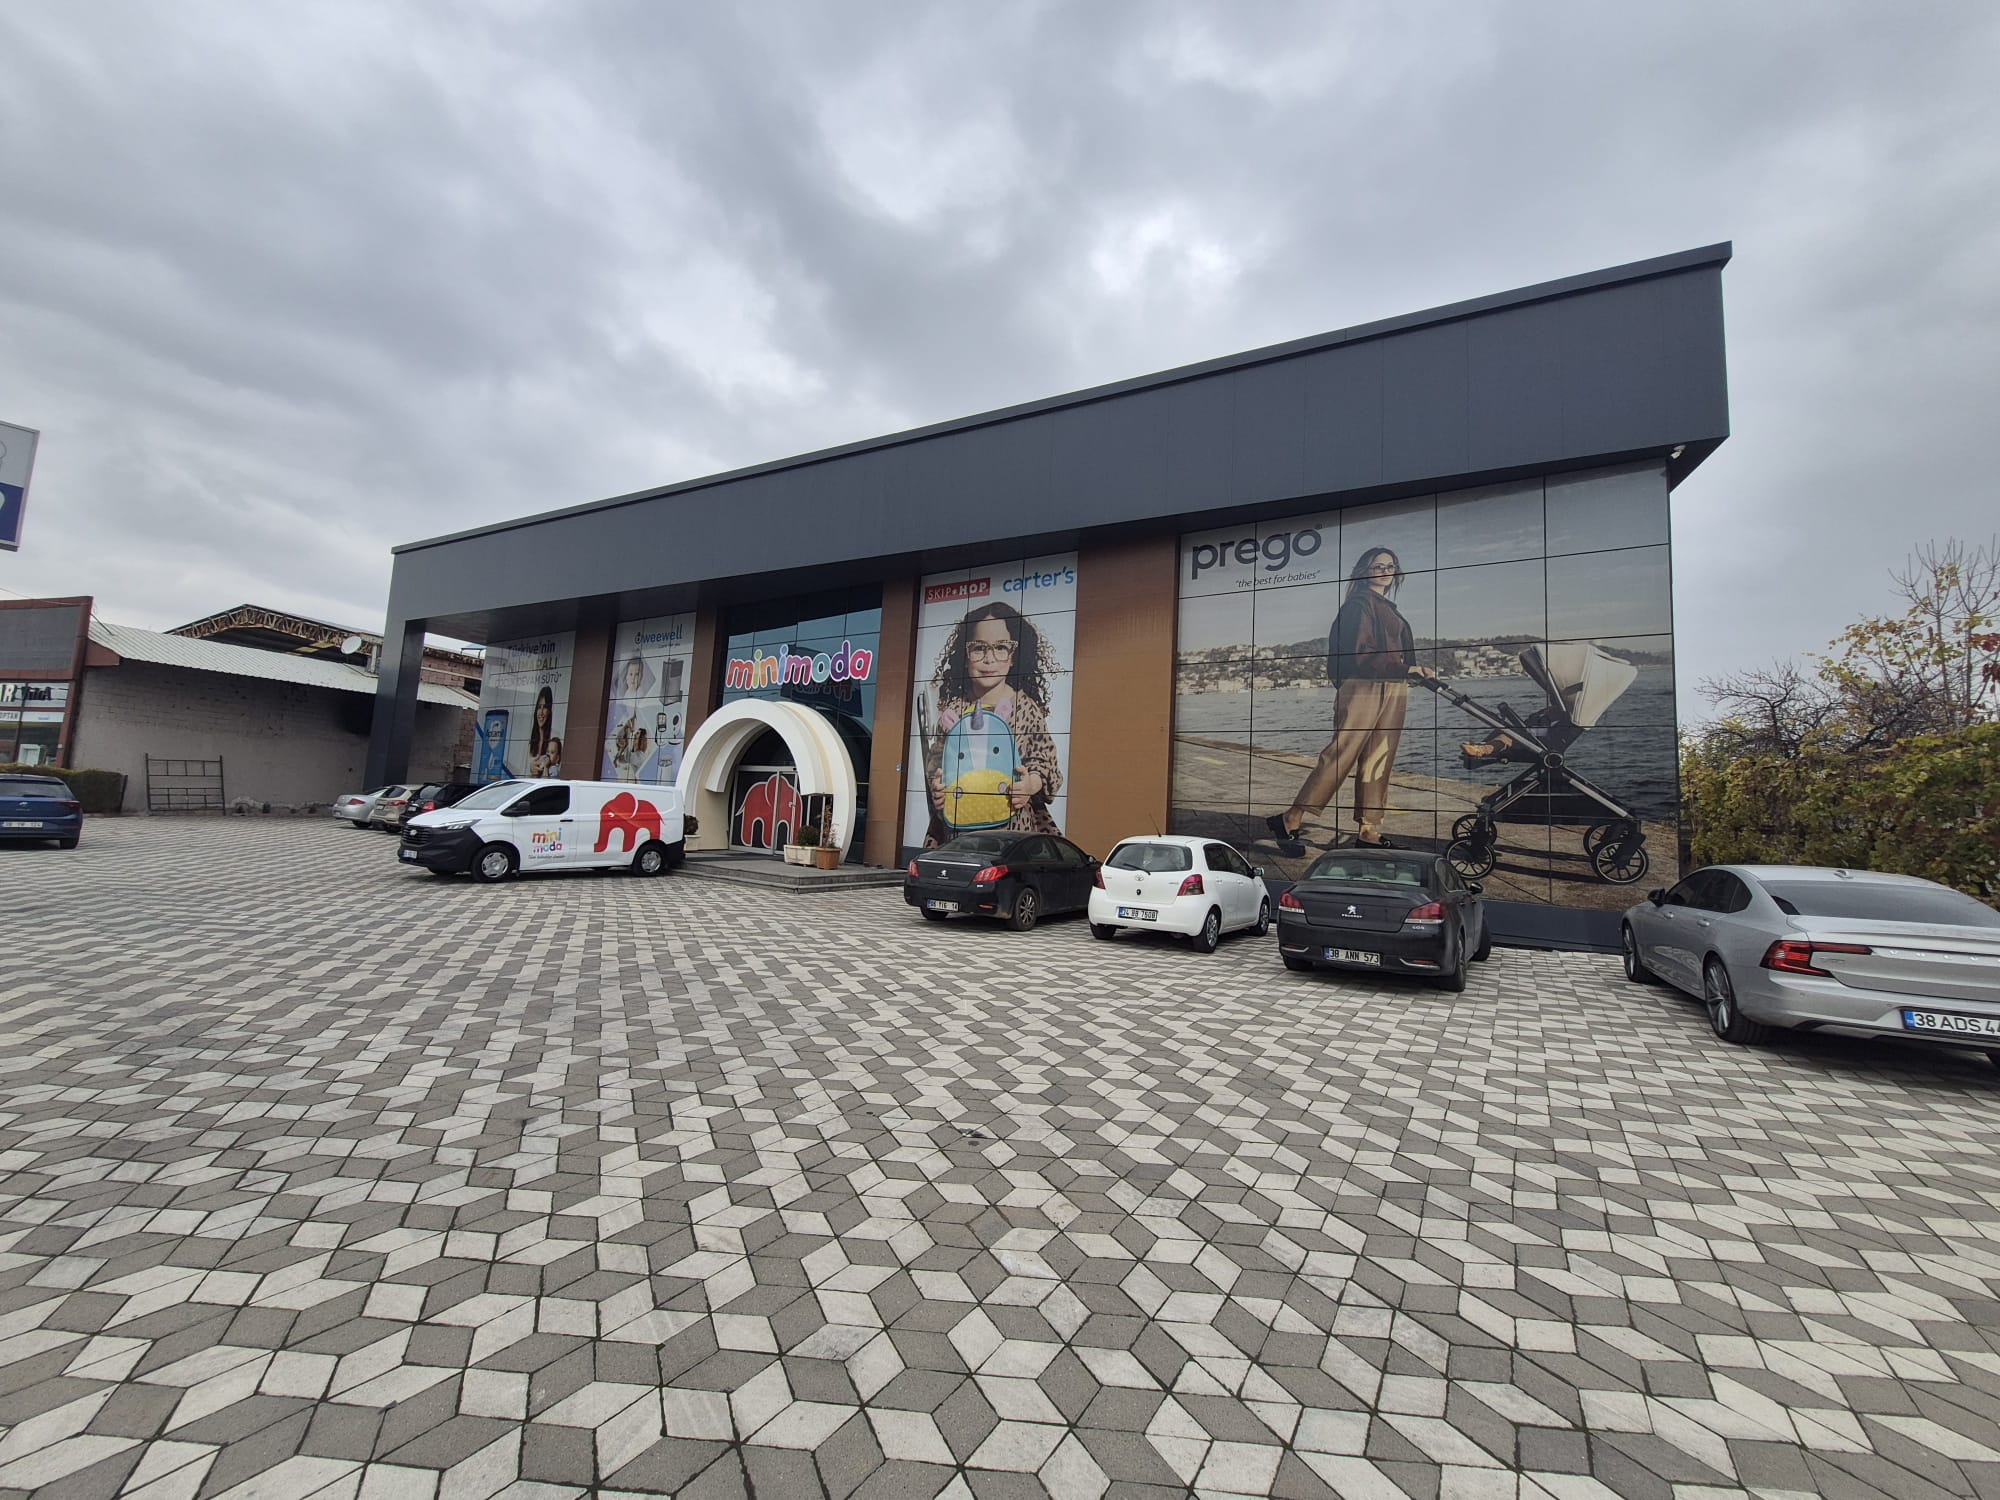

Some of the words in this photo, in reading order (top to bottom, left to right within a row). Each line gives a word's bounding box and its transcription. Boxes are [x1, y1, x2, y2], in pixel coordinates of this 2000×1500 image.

[1191, 529, 1322, 580] prego
[1002, 566, 1075, 592] carter's
[927, 587, 952, 600] SKIP
[958, 582, 987, 597] HOP
[725, 640, 873, 690] minimoda
[1344, 951, 1360, 961] ANN
[1363, 954, 1379, 963] 573
[1914, 1013, 1937, 1028] 38
[1940, 1016, 1982, 1032] ADS
